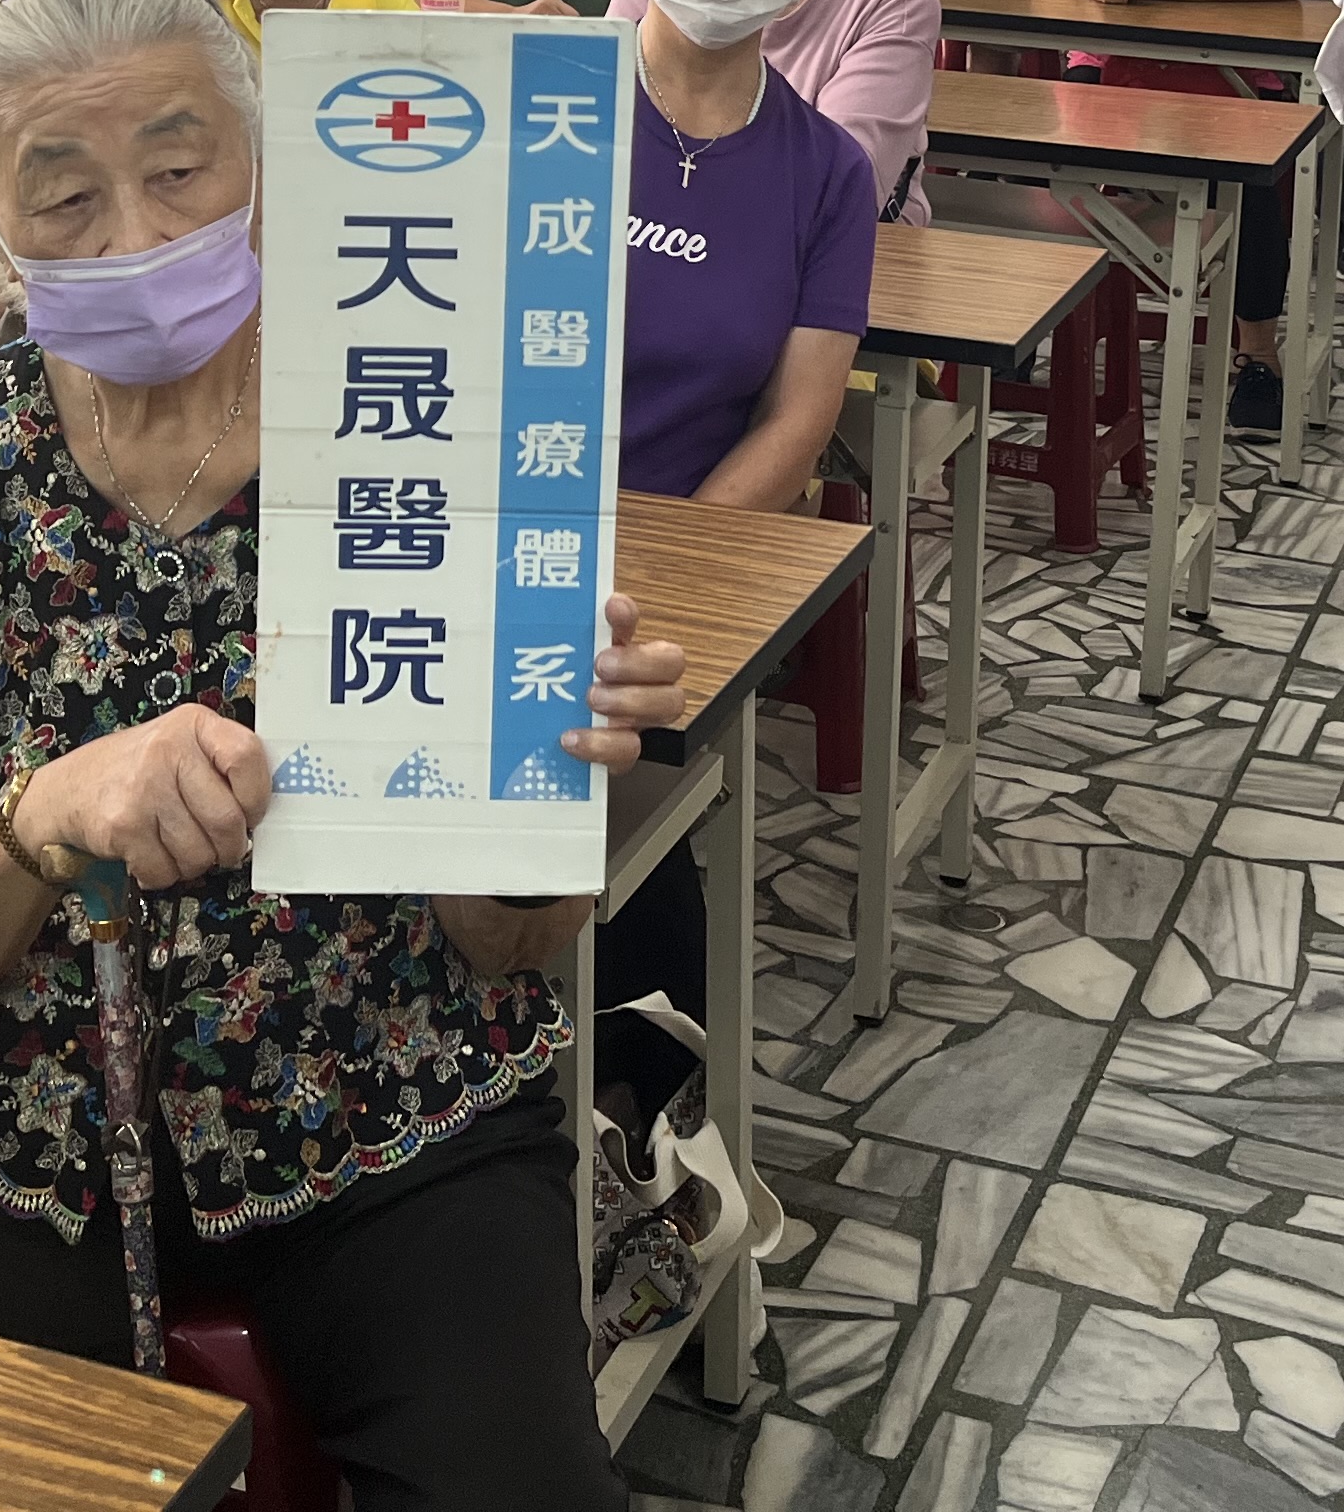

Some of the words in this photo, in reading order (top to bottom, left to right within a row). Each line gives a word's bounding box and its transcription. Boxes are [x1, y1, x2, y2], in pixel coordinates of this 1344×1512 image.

[330, 216, 458, 705] 天晟醫院
[510, 94, 599, 702] 天成醫療體系
[627, 215, 707, 263] ance
